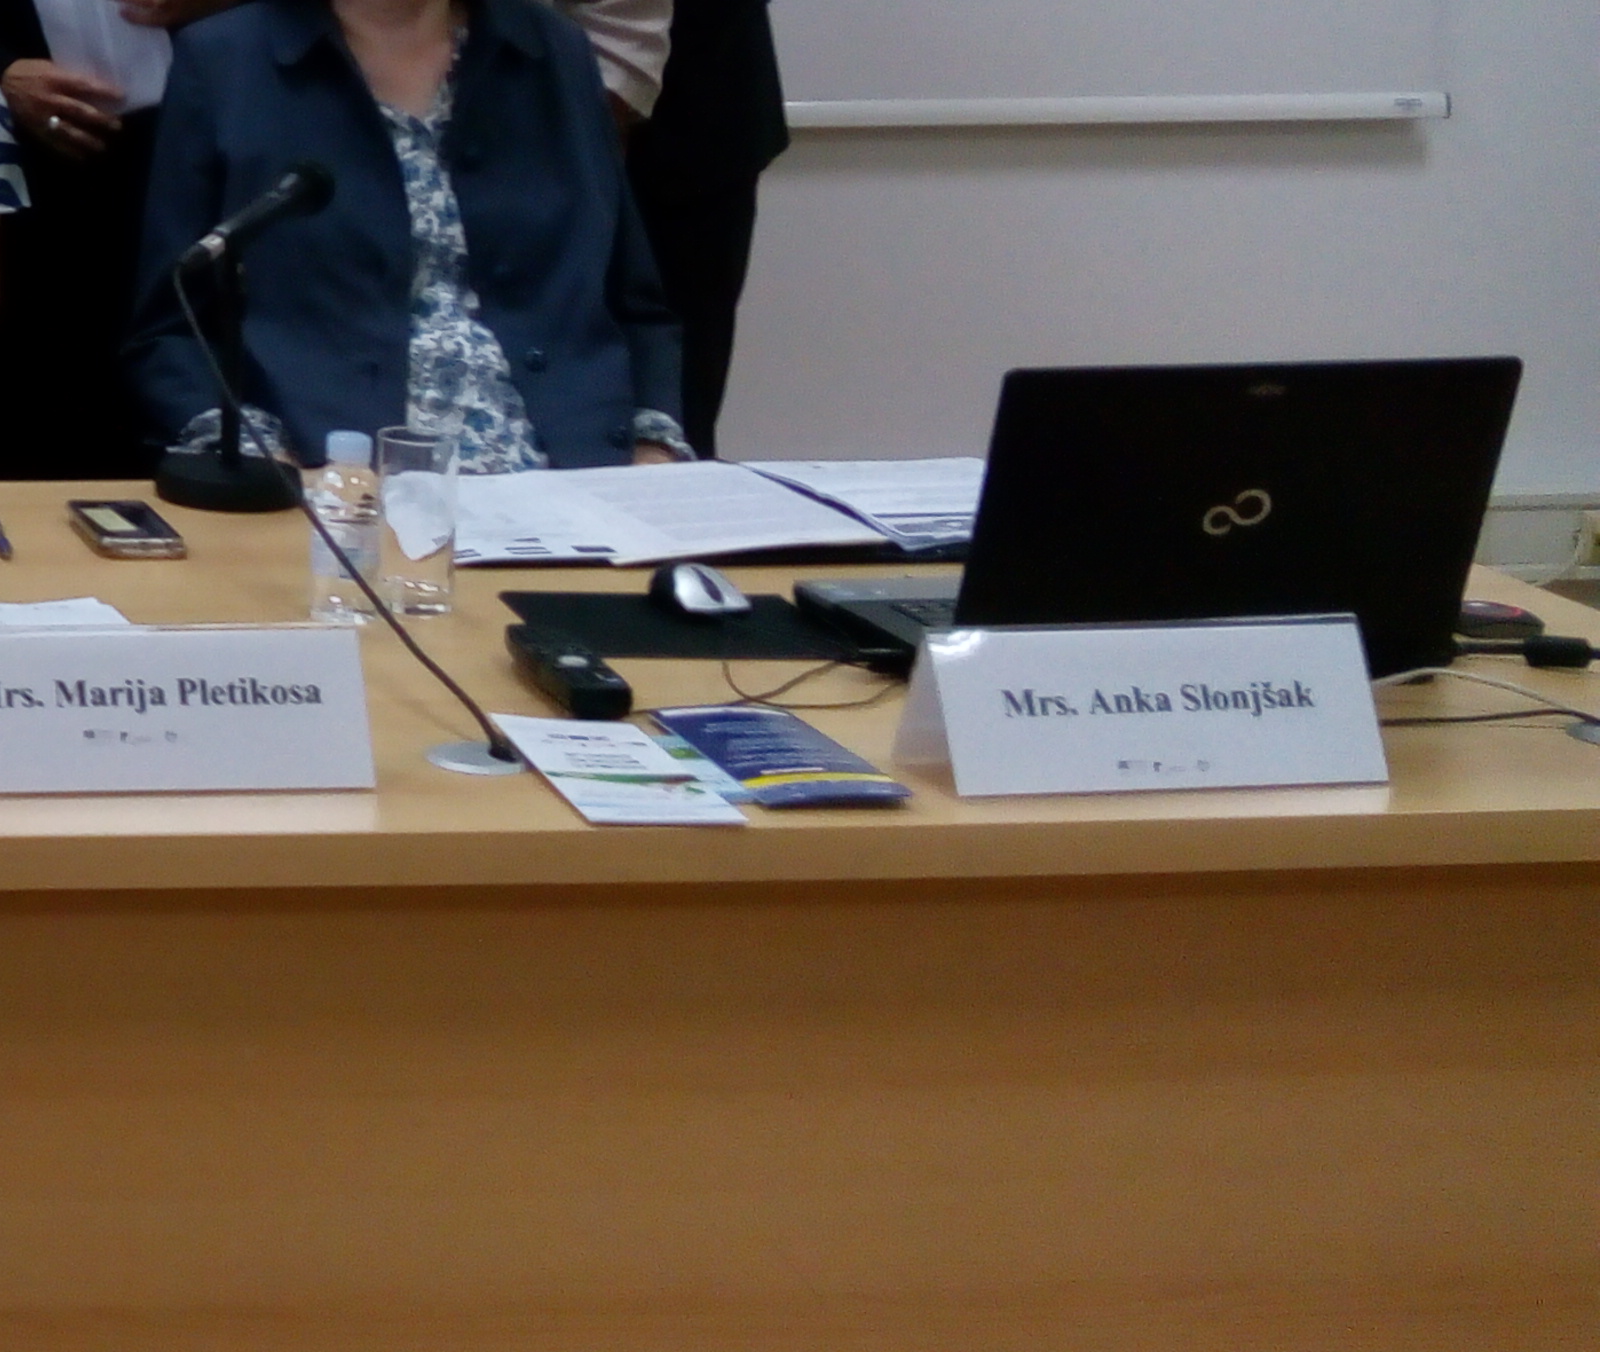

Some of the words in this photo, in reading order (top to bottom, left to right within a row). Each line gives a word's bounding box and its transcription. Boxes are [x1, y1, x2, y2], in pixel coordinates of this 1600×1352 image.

[53, 679, 167, 714] Marija
[176, 677, 322, 706] Pletikosa
[1001, 688, 1079, 717] Mrs.
[1089, 685, 1173, 715] Anka
[1179, 680, 1315, 717] Slonjšak
